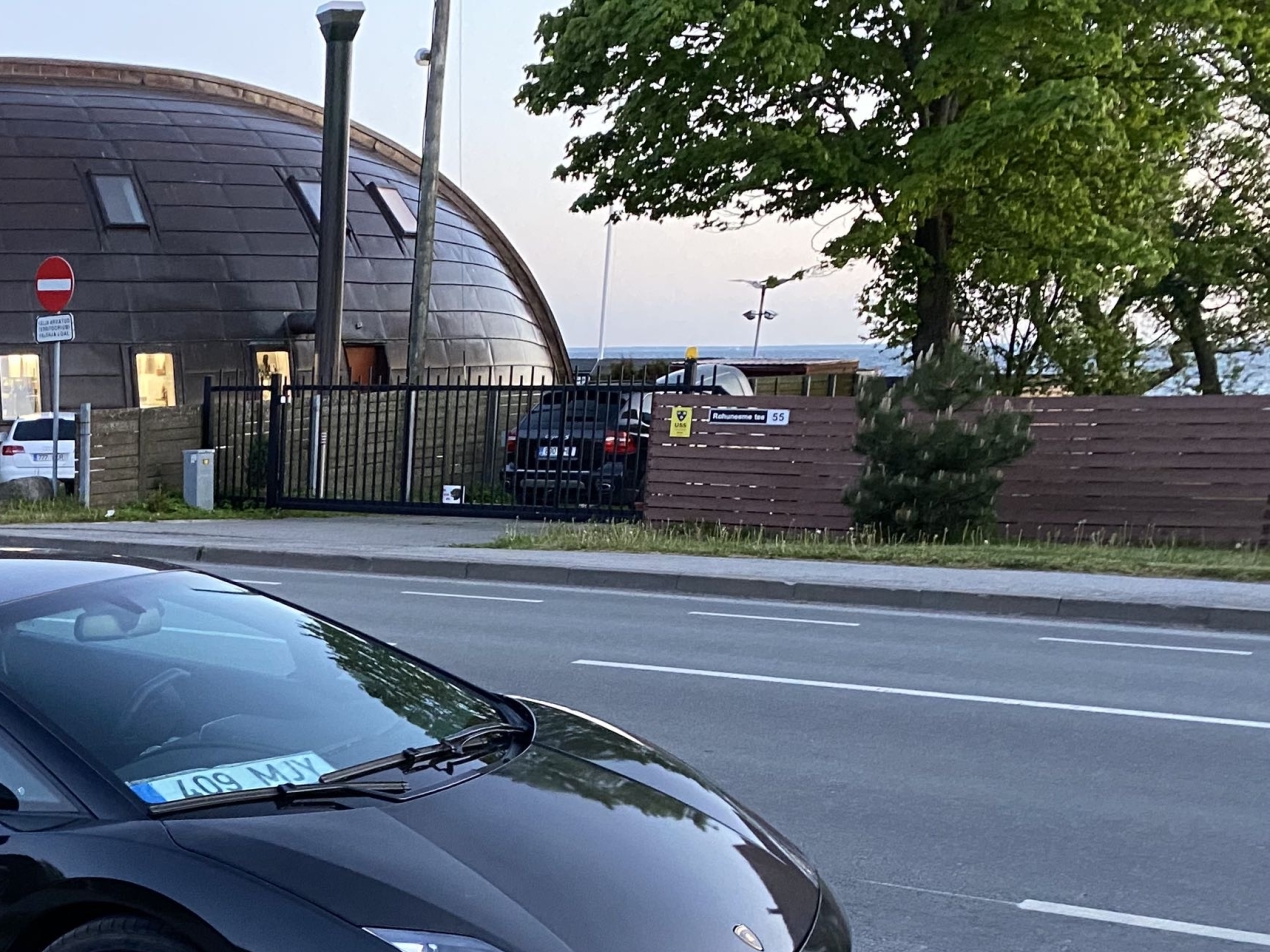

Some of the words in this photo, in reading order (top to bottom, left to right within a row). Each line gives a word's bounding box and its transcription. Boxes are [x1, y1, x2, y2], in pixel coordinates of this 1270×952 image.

[772, 412, 786, 422] 55
[176, 771, 244, 799] 409
[247, 757, 321, 787] MJY
